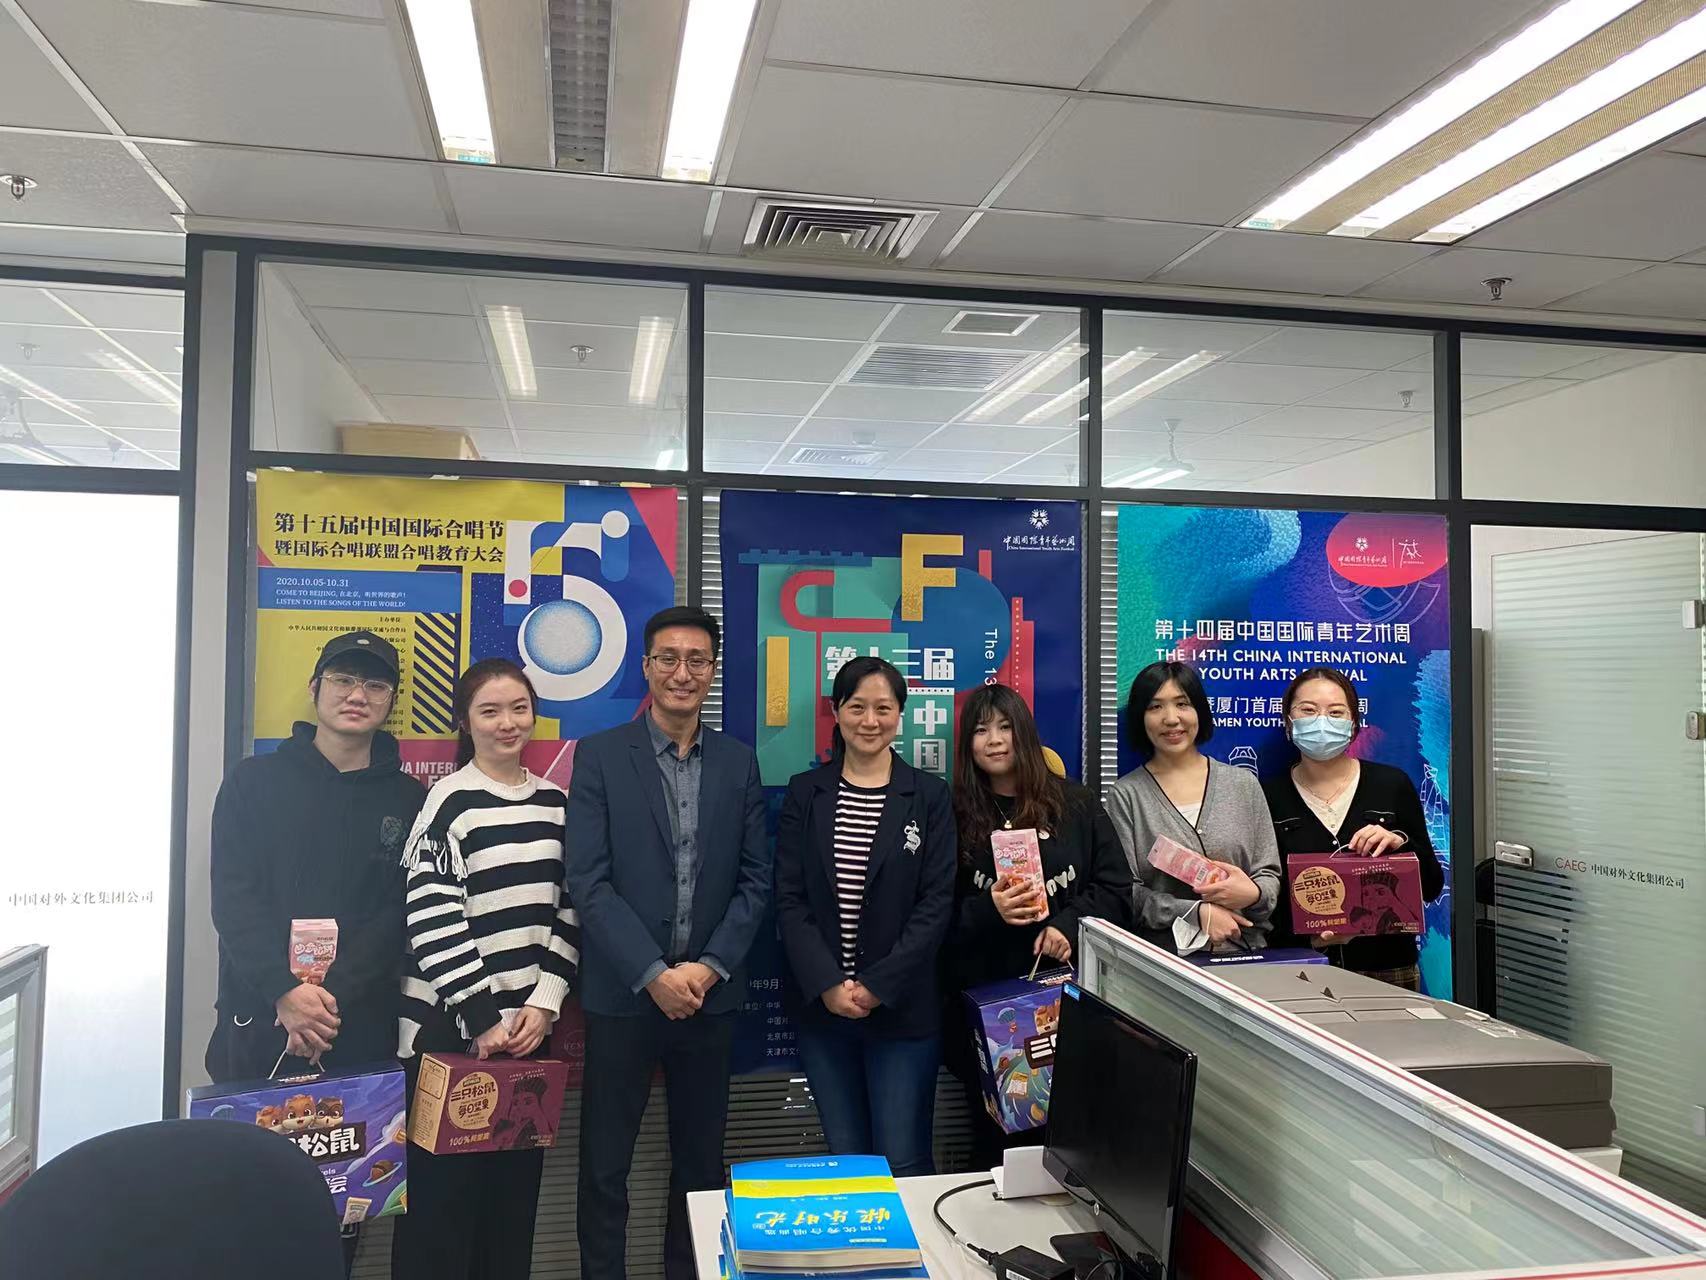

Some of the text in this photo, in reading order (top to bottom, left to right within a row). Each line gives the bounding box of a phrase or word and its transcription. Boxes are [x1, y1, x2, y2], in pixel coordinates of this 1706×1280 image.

[274, 512, 504, 540] 第十五届中国国际合唱节
[274, 539, 504, 562] 暨国际合唱联盟合唱教育大会
[276, 577, 350, 588] 2020.10.05-10.31
[275, 588, 298, 597] COME
[299, 589, 308, 597] TO
[309, 589, 338, 599] BEIJING,
[275, 597, 407, 608] LISTEN TO THE SONGS OF THE WORLD!
[1155, 618, 1411, 644] 第十四届中国国际青年艺术周
[984, 628, 998, 660] The
[1155, 648, 1407, 664] THE 14TH CHINA INTERNATIONAL
[1198, 667, 1254, 681] YOUTH
[1259, 668, 1297, 681] ARTS
[1245, 718, 1288, 728] YOUTH
[1554, 857, 1685, 889] CAEG 中国对外文化集团公司
[1293, 875, 1341, 892] 三只松鼠
[8, 890, 153, 907] 中国对外文化集团公司
[450, 1081, 497, 1102] 三只松鼠
[458, 1098, 490, 1119] 每日坚果
